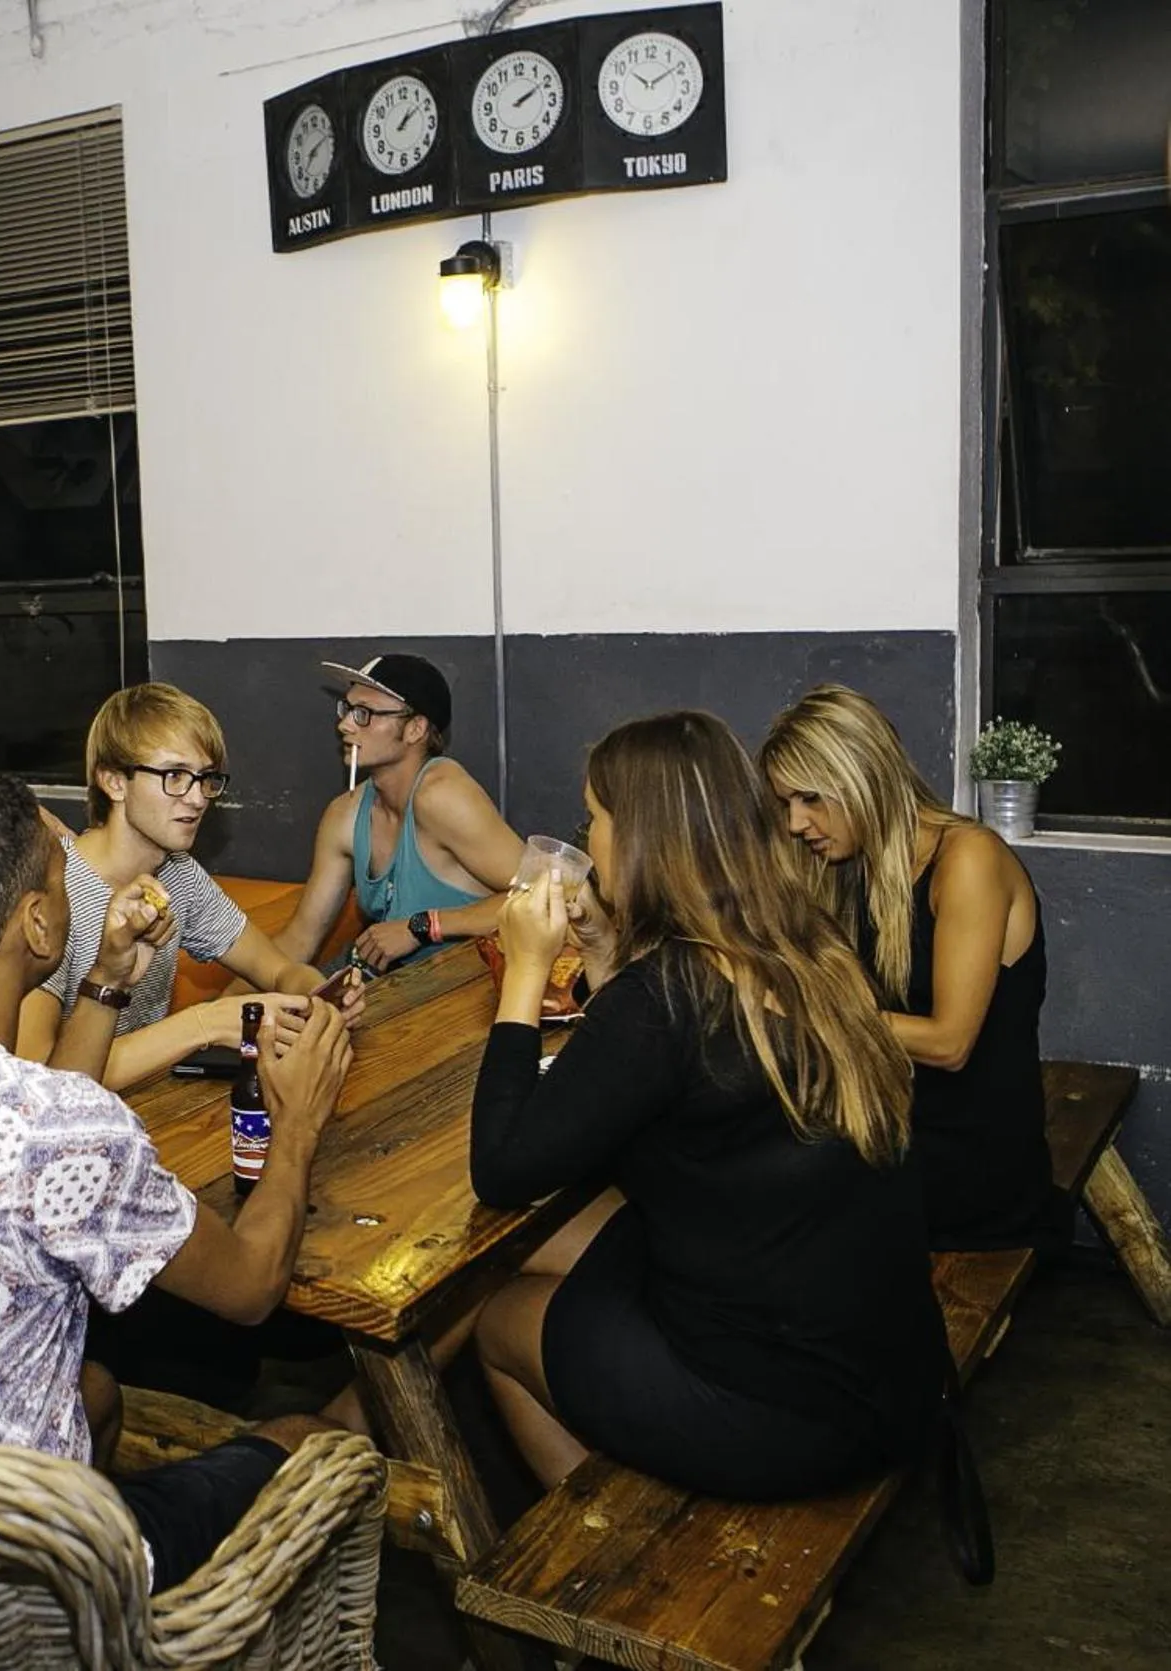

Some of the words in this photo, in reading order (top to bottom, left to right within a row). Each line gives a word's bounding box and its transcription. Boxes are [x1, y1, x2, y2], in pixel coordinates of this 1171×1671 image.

[628, 50, 638, 63] 11
[645, 45, 657, 59] 12
[514, 63, 524, 76] 12
[614, 60, 626, 76] 10
[677, 61, 686, 75] 2
[498, 70, 508, 83] 11
[543, 75, 552, 88] 2
[487, 82, 498, 96] 10
[610, 80, 619, 95] 9
[682, 80, 690, 94] 3
[548, 92, 557, 107] 3
[614, 98, 623, 113] 8
[673, 98, 682, 112] 4
[484, 102, 493, 116] 9
[489, 118, 497, 132] 8
[542, 111, 550, 125] 4
[626, 112, 635, 124] 7
[644, 115, 652, 129] 6
[501, 130, 508, 143] 7
[515, 131, 524, 145] 6
[532, 126, 539, 139] 5
[623, 153, 686, 177] TOKYO
[490, 165, 544, 192] PARIS
[371, 184, 433, 214] LONDON
[288, 208, 331, 236] AUSTIN
